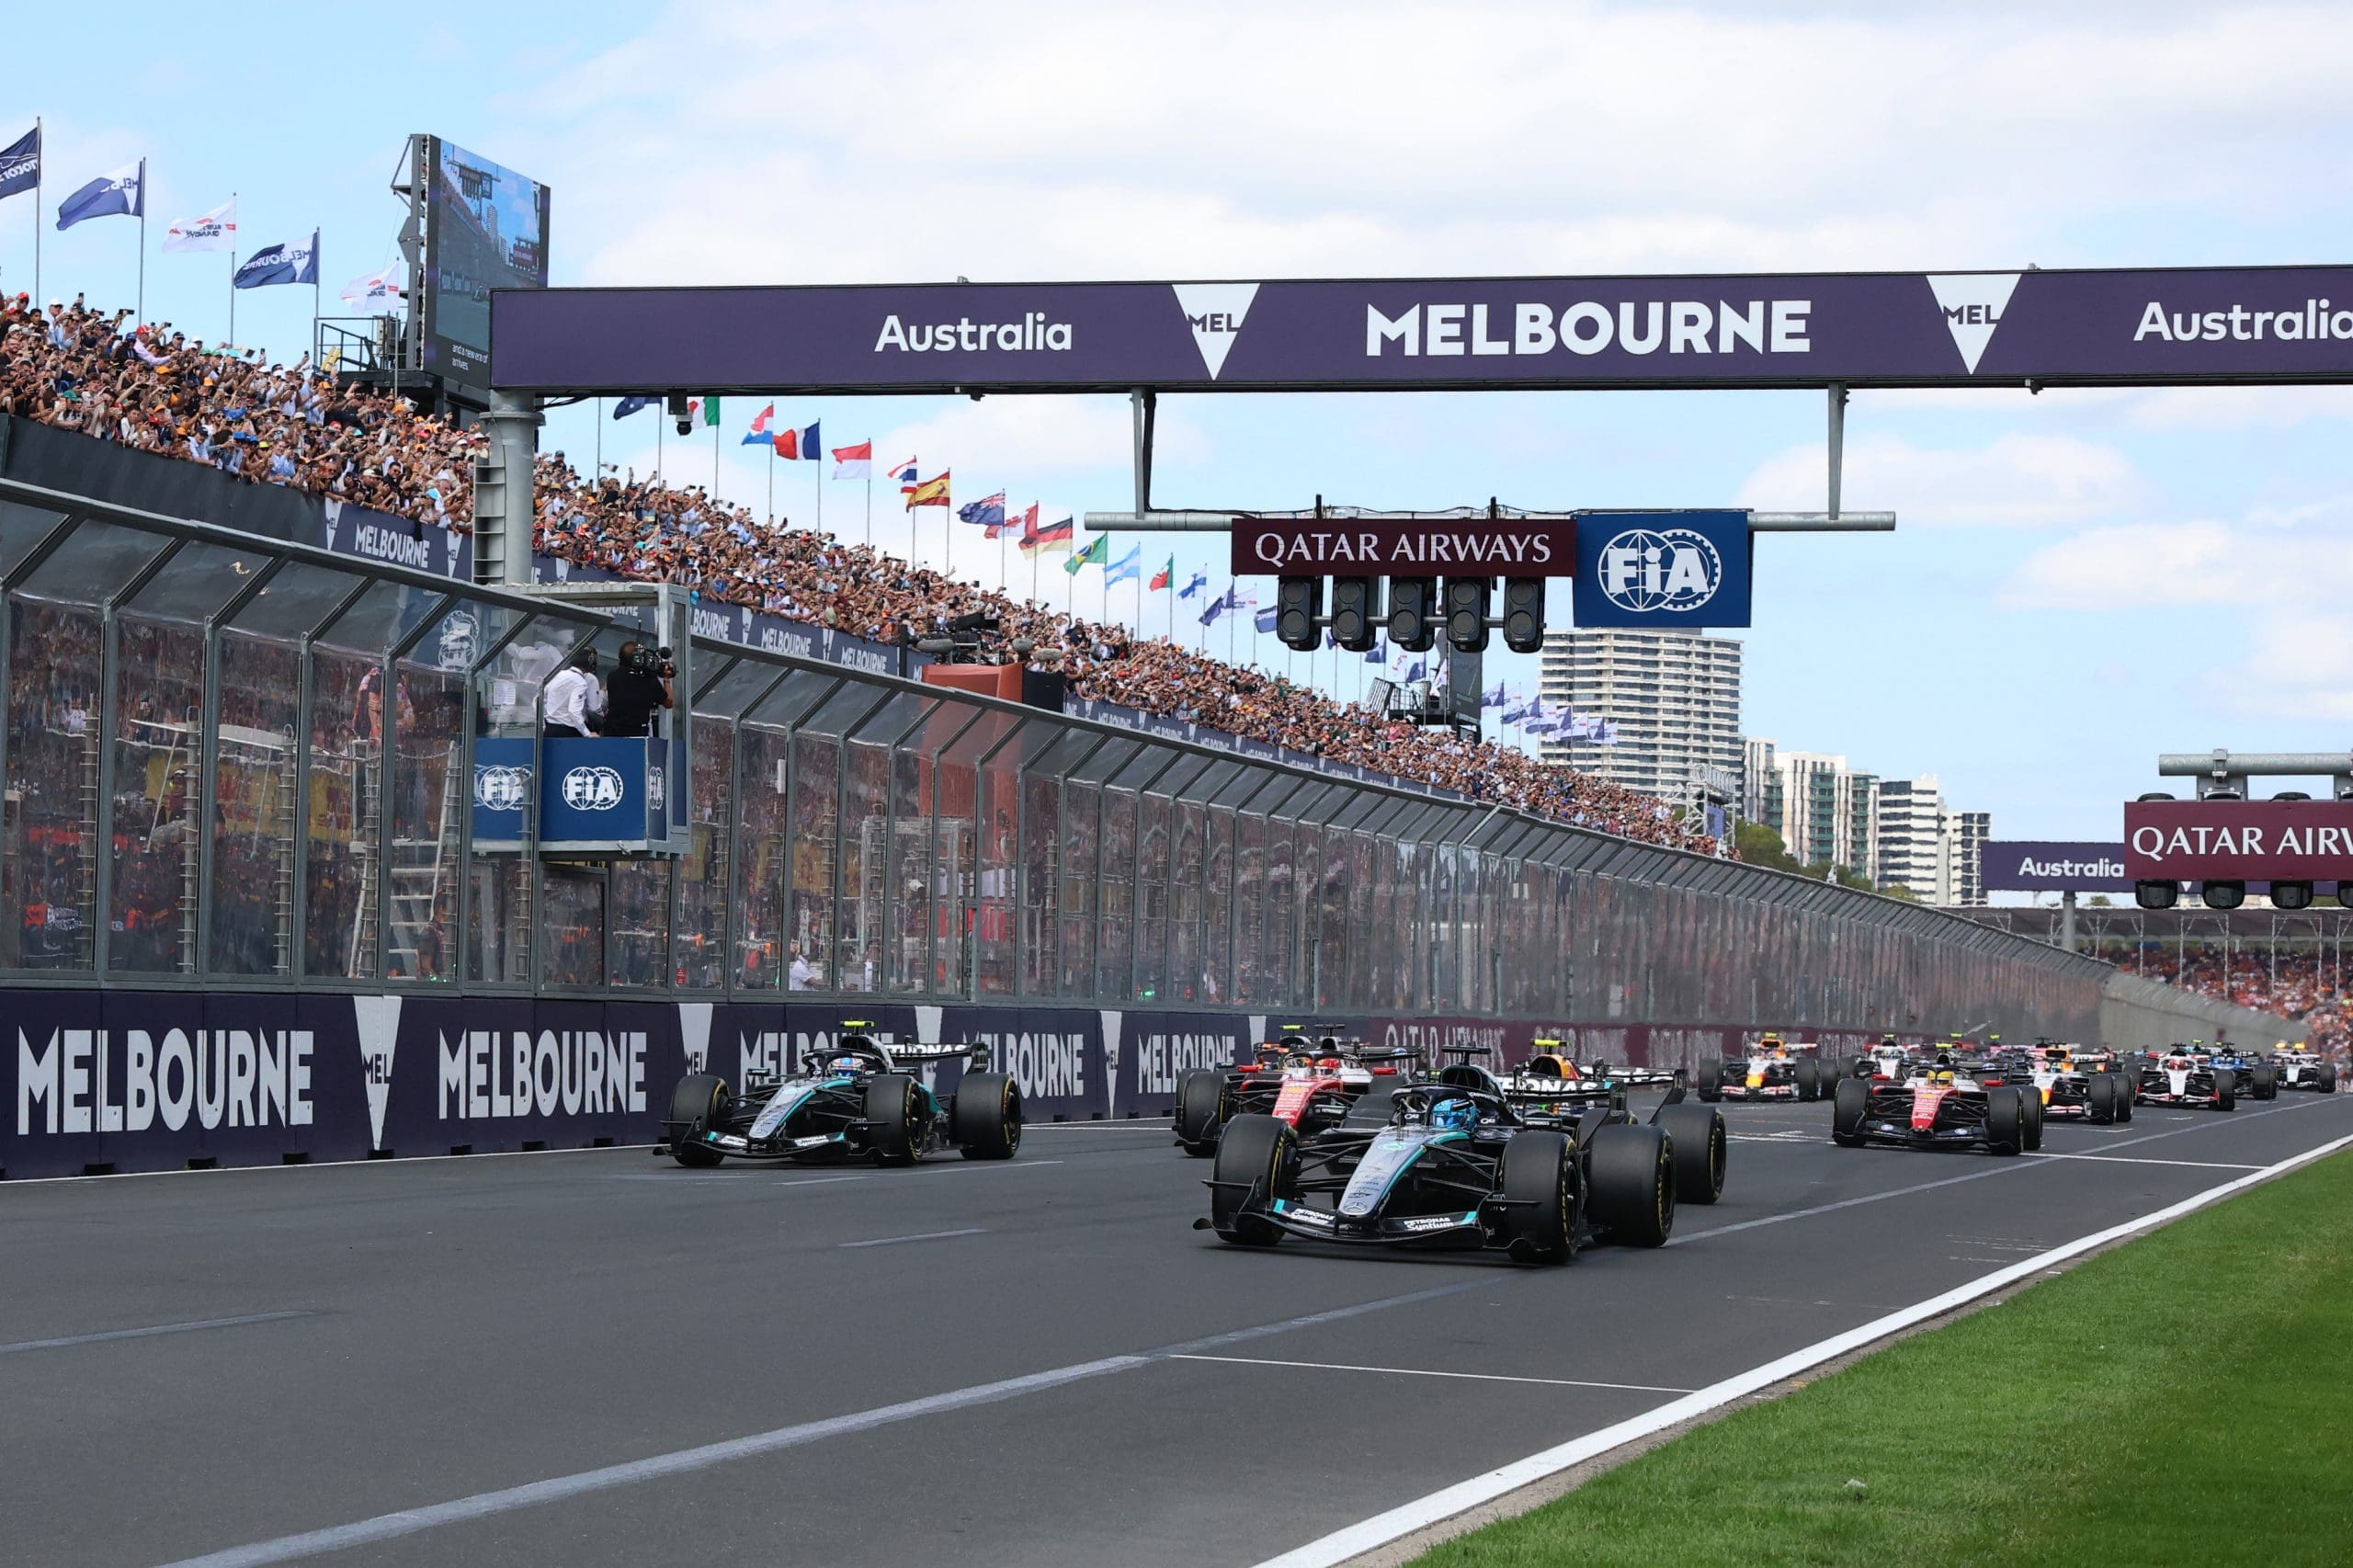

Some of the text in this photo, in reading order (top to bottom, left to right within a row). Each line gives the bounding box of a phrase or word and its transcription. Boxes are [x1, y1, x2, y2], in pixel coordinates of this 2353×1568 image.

[1187, 312, 1241, 333] MEL
[1366, 300, 1811, 356] MELBOURNE
[1942, 304, 2000, 325] MEL
[2132, 299, 2353, 341] Australia
[874, 312, 1073, 353] Australia
[355, 523, 430, 569] MELBOURNE
[1255, 533, 1552, 567] QATAR AIRWAYS
[761, 627, 813, 657] MELBOURNE
[841, 646, 888, 675] MELBOURNE
[2132, 826, 2266, 862] QATAR
[2018, 856, 2125, 878] Australia
[18, 1025, 313, 1135] MELBOURNE
[361, 1053, 392, 1085] MEL
[439, 1027, 647, 1121] MELBOURNE
[685, 1051, 706, 1075] MEL
